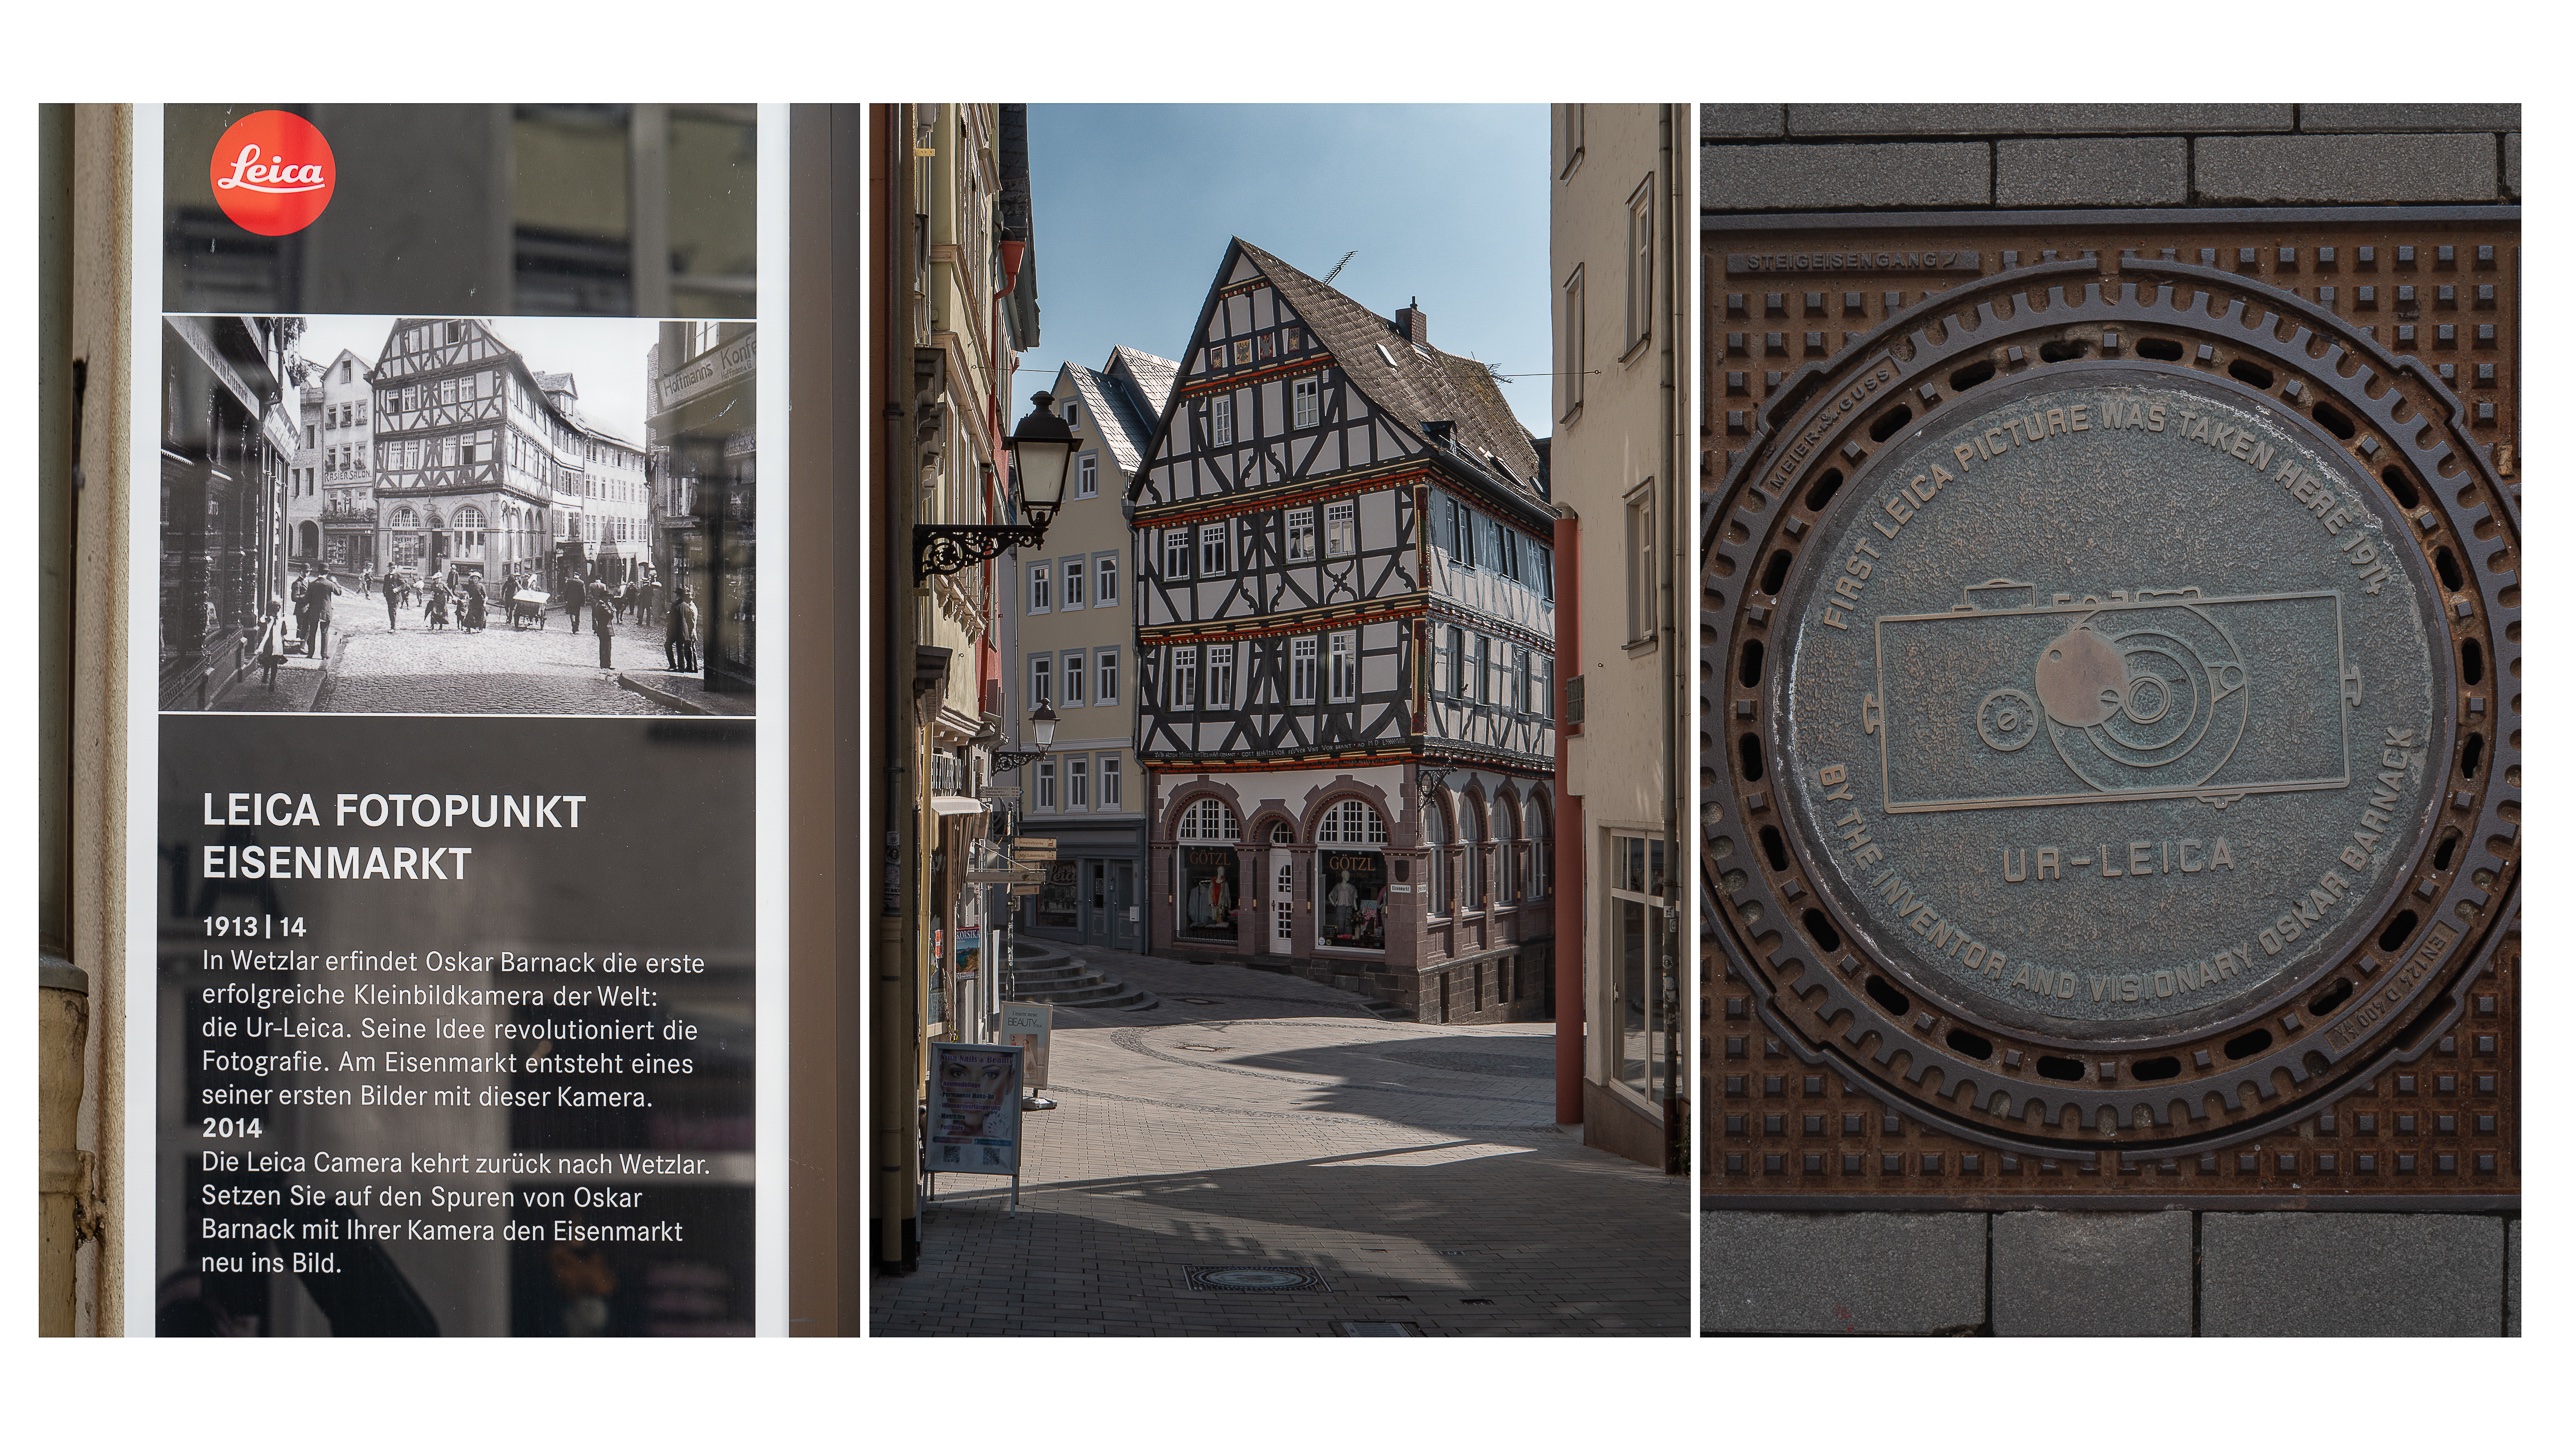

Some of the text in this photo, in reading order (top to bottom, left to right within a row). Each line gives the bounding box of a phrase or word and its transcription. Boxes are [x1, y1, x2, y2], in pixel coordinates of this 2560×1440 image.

[217, 143, 326, 194] Leica
[1748, 252, 1937, 271] STEIGEISENGANG
[1839, 368, 1890, 411] GUSS
[1823, 404, 2391, 631] FIRST LEICA PICTURE WAS TAKEN HERE 1914
[204, 792, 587, 828] LEICA FOTOPUNKT
[203, 845, 472, 880] EISENMARKT
[1189, 849, 1231, 866] GÖTZL
[1329, 853, 1376, 871] GÖTZL
[1819, 726, 2414, 1002] BY THE INVENTOR AND VISIONARY OSKAR BARNACK
[2003, 836, 2234, 883] UR-LEICA
[203, 949, 705, 974] In Wetzlar erfindet Oskar Barnack die erste
[2400, 959, 2428, 987] 124
[202, 982, 657, 1010] erfolgreiche Kleinbildkamera der Welt:
[2385, 987, 2401, 1002] D
[1008, 1017, 1038, 1027] BEAUTY
[2356, 1001, 2385, 1028] 400
[202, 1016, 698, 1041] die Ur-Leica. Seine Idee revolutioniert die
[203, 1049, 693, 1077] Fotografie. Am Eisenmarkt entsteht eines
[959, 1055, 977, 1063] Nails
[987, 1056, 1013, 1064] Beauty
[202, 1083, 652, 1108] seiner ersten Bilder mit dieser Kamera.
[202, 1117, 263, 1139] 2014
[203, 1150, 710, 1175] Die Leica Camera kehrt zurück nach Wetzlar.
[202, 1184, 643, 1213] Setzen Sie auf den Spuren von Oskar
[202, 1217, 683, 1242] Barnack mit Ihrer Kamera den Eisenmarkt
[202, 1251, 341, 1274] neu ins Bild.
